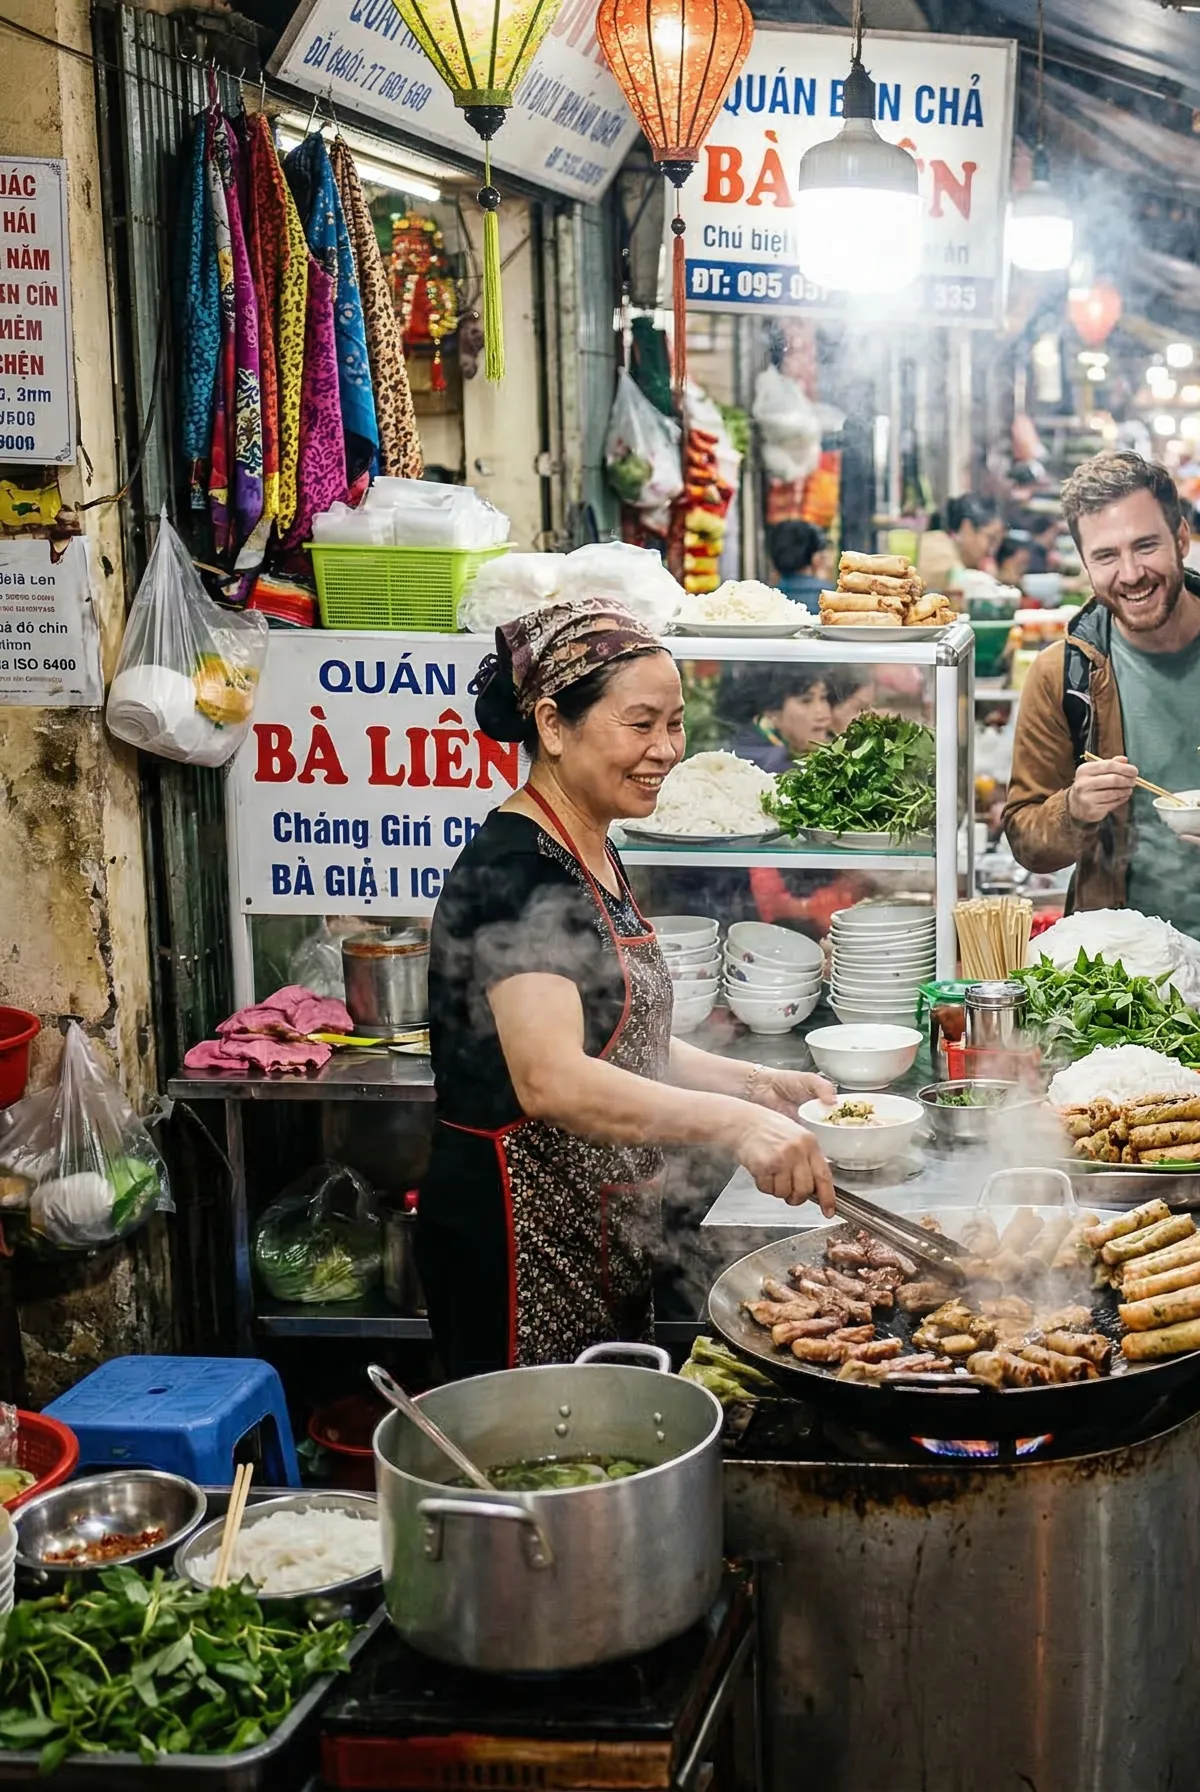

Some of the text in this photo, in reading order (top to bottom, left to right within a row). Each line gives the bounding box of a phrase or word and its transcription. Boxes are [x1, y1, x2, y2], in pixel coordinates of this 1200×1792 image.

[829, 79, 901, 121] BN
[914, 73, 984, 127] CHẢ
[704, 130, 796, 207] BÀ
[3, 206, 36, 234] HÁI
[7, 244, 51, 271] NĂM
[692, 267, 731, 295] ĐT:
[737, 270, 783, 299] 095
[13, 658, 39, 671] ISO
[43, 658, 76, 671] 6400
[318, 653, 456, 696] QUÁN
[252, 705, 520, 791] BÀ LIÊN
[410, 867, 451, 899] IC
